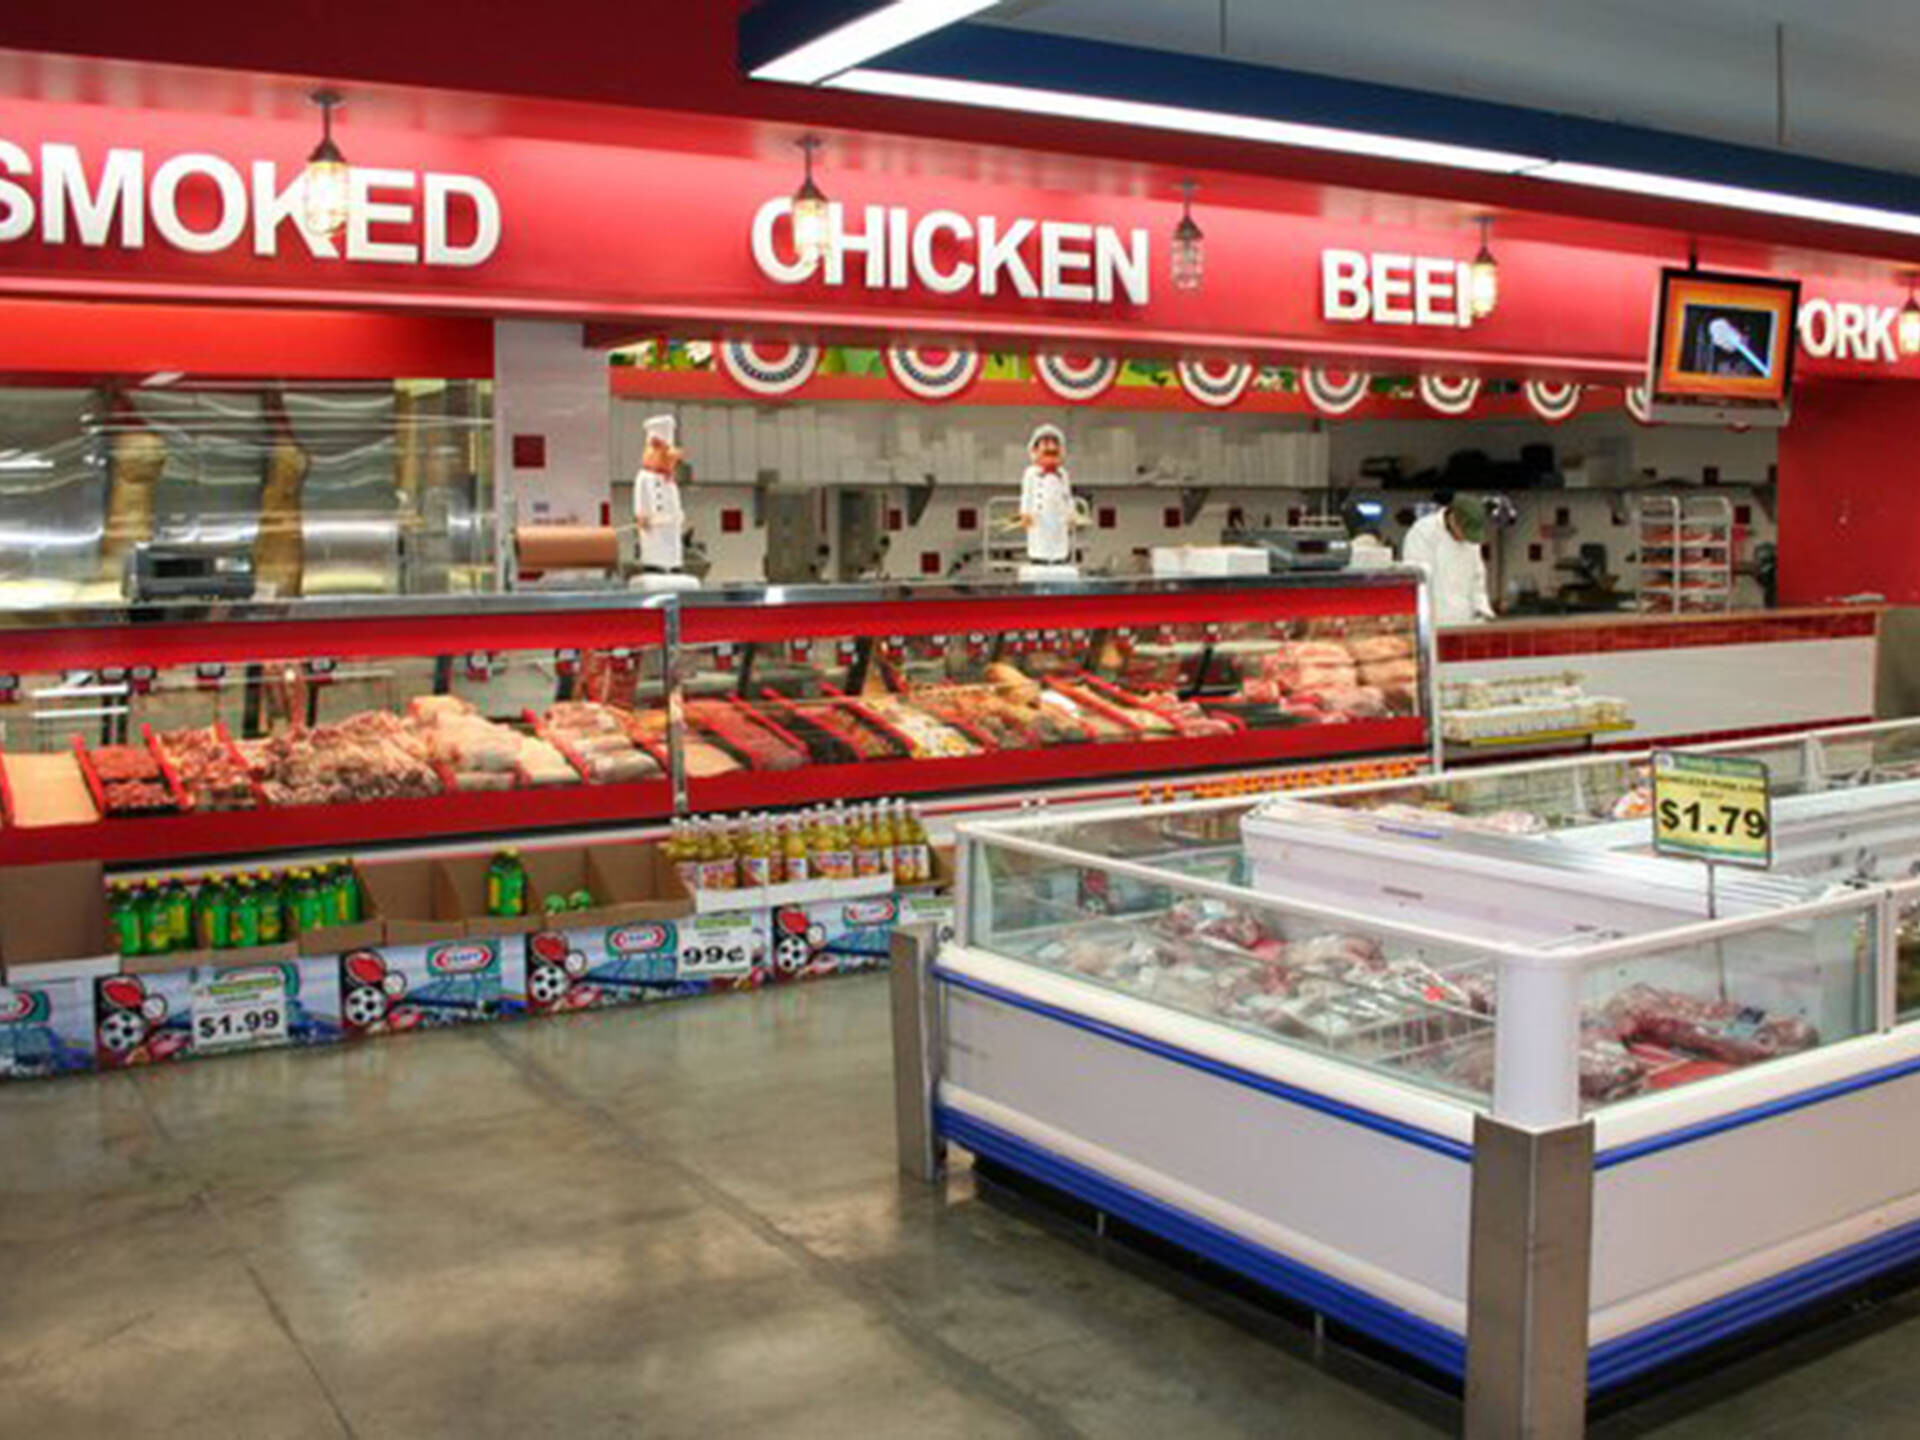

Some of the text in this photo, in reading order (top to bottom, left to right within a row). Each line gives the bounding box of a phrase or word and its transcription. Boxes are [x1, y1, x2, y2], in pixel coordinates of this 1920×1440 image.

[752, 196, 1149, 304] CHICKEN
[1797, 298, 1897, 362] ORK
[1660, 798, 1767, 839] $1.79
[199, 1008, 279, 1038] $1.99
